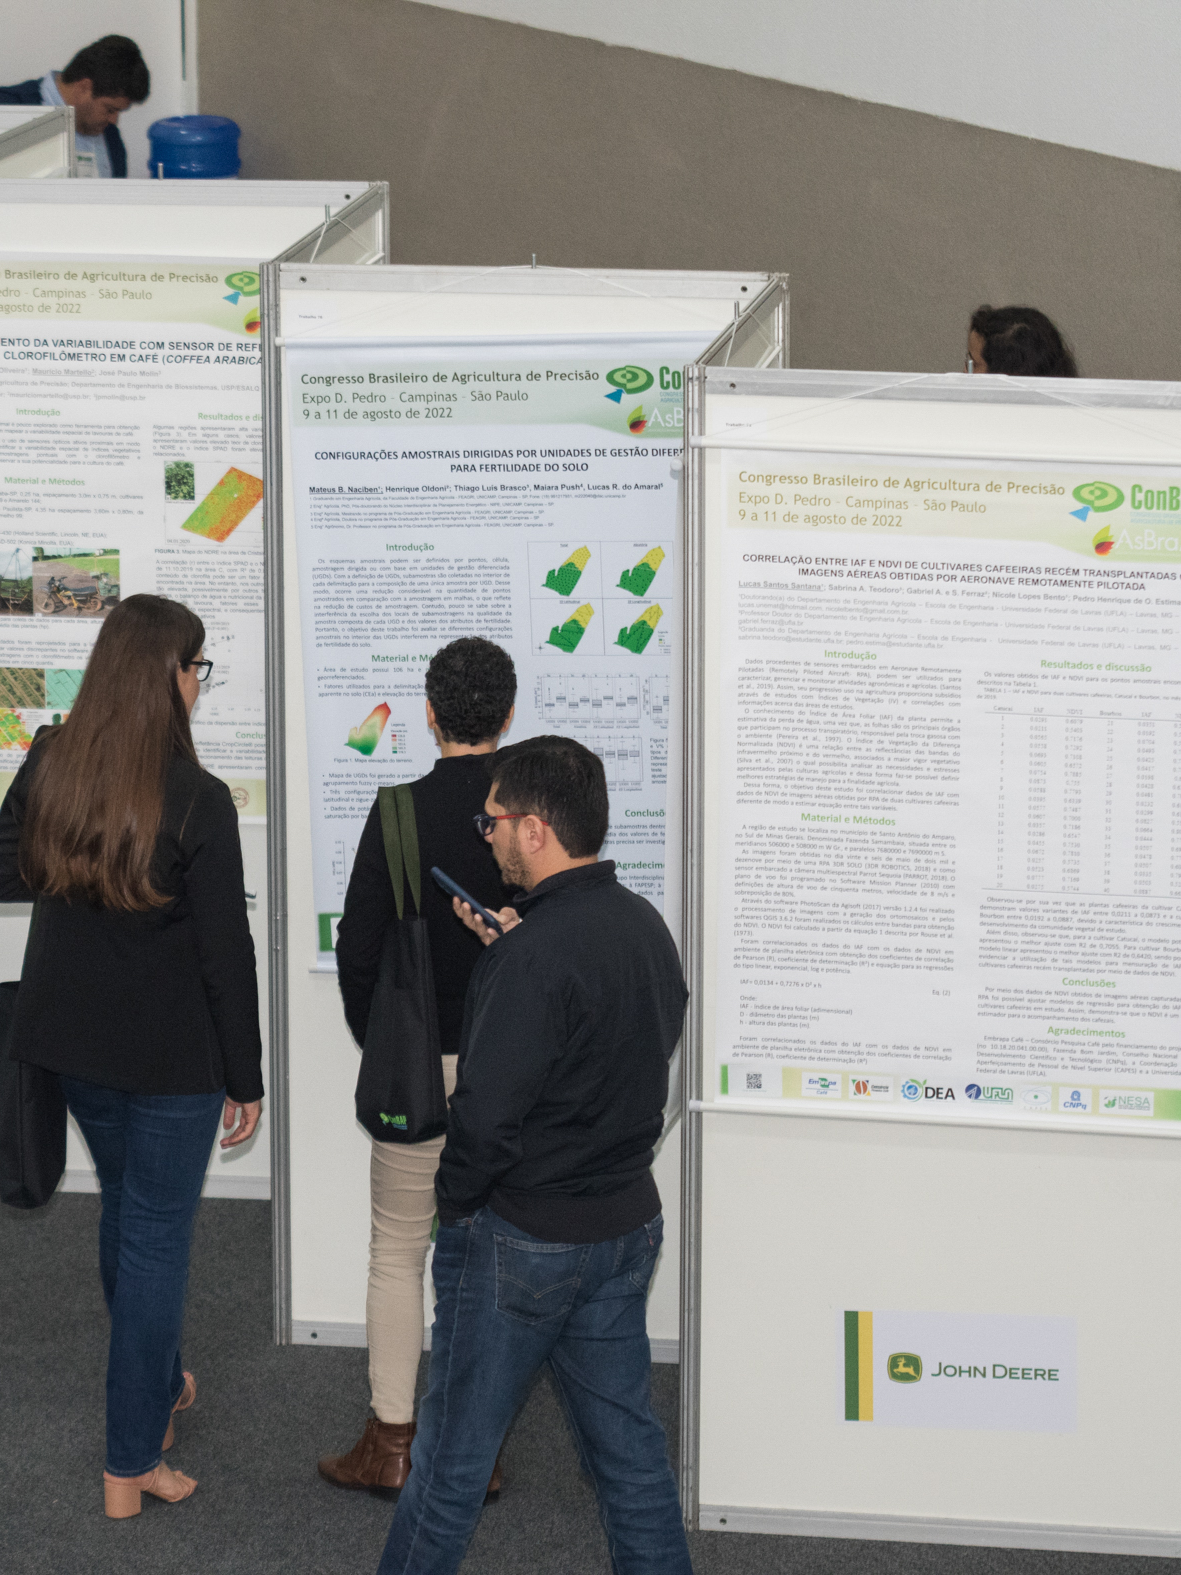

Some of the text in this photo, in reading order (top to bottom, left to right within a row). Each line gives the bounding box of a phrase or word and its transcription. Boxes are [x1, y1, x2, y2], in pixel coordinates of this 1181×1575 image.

[3, 268, 61, 280] Brasileiro
[63, 270, 79, 280] de
[81, 271, 147, 284] Agricultura
[150, 272, 166, 282] de
[168, 271, 219, 283] Precisão
[33, 338, 49, 347] DA
[51, 339, 136, 349] VARIABILIDADE
[139, 341, 165, 350] COM
[168, 341, 215, 350] SENSOR
[217, 342, 232, 351] DE
[3, 350, 107, 361] CLOROFILÔMETRO
[109, 353, 126, 362] EM
[129, 353, 159, 362] CAFÉ
[162, 354, 211, 364] (COFFEA
[300, 370, 600, 387] Congresso Brasileiro de Agricultura de Precisão
[302, 389, 529, 406] Expo D. Pedro Campinas São Paulo
[15, 408, 61, 417] Introdução
[302, 406, 453, 421] 9 a 11 de agosto de 2022
[314, 450, 399, 461] CONFIGURAÇÕES
[401, 450, 461, 459] AMOSTRAIS
[463, 449, 514, 458] DIRIGIDAS
[516, 449, 537, 458] POR
[539, 448, 592, 457] UNIDADES
[594, 448, 607, 457] DE
[609, 446, 649, 457] GESTÃO
[450, 462, 589, 472] PARA FERTILIDADE DO SOLO
[738, 471, 1066, 495] Congresso Brasileiro de Agricultura de Precisão
[738, 491, 987, 513] Expo D. Pedro Campinas São Paulo
[738, 508, 903, 527] 9 a 11 de agosto de 2022
[385, 542, 435, 552] Introdução
[742, 553, 1177, 580] CORRELAÇÃO ENTRE IAF E NDVI DE CULTIVARES CAFEEIRAS RECÉM TRANSPLANTADAS
[798, 567, 1146, 590] IMAGENS AÉREAS OBTIDAS POR AERONAVE REMOTAMENTE PILOTADA
[824, 650, 878, 660] Introdução
[1040, 659, 1094, 670] Resultados
[1105, 662, 1152, 672] discussão
[801, 812, 842, 823] Material
[852, 816, 896, 825] Métodos
[1061, 977, 1117, 988] Conclusões
[1047, 1026, 1126, 1038] Agradecimentos
[925, 1086, 955, 1100] DEA
[1063, 1101, 1087, 1110] CNPq
[1119, 1096, 1151, 1106] NESA
[931, 1362, 1060, 1382] JOHN DEERE
